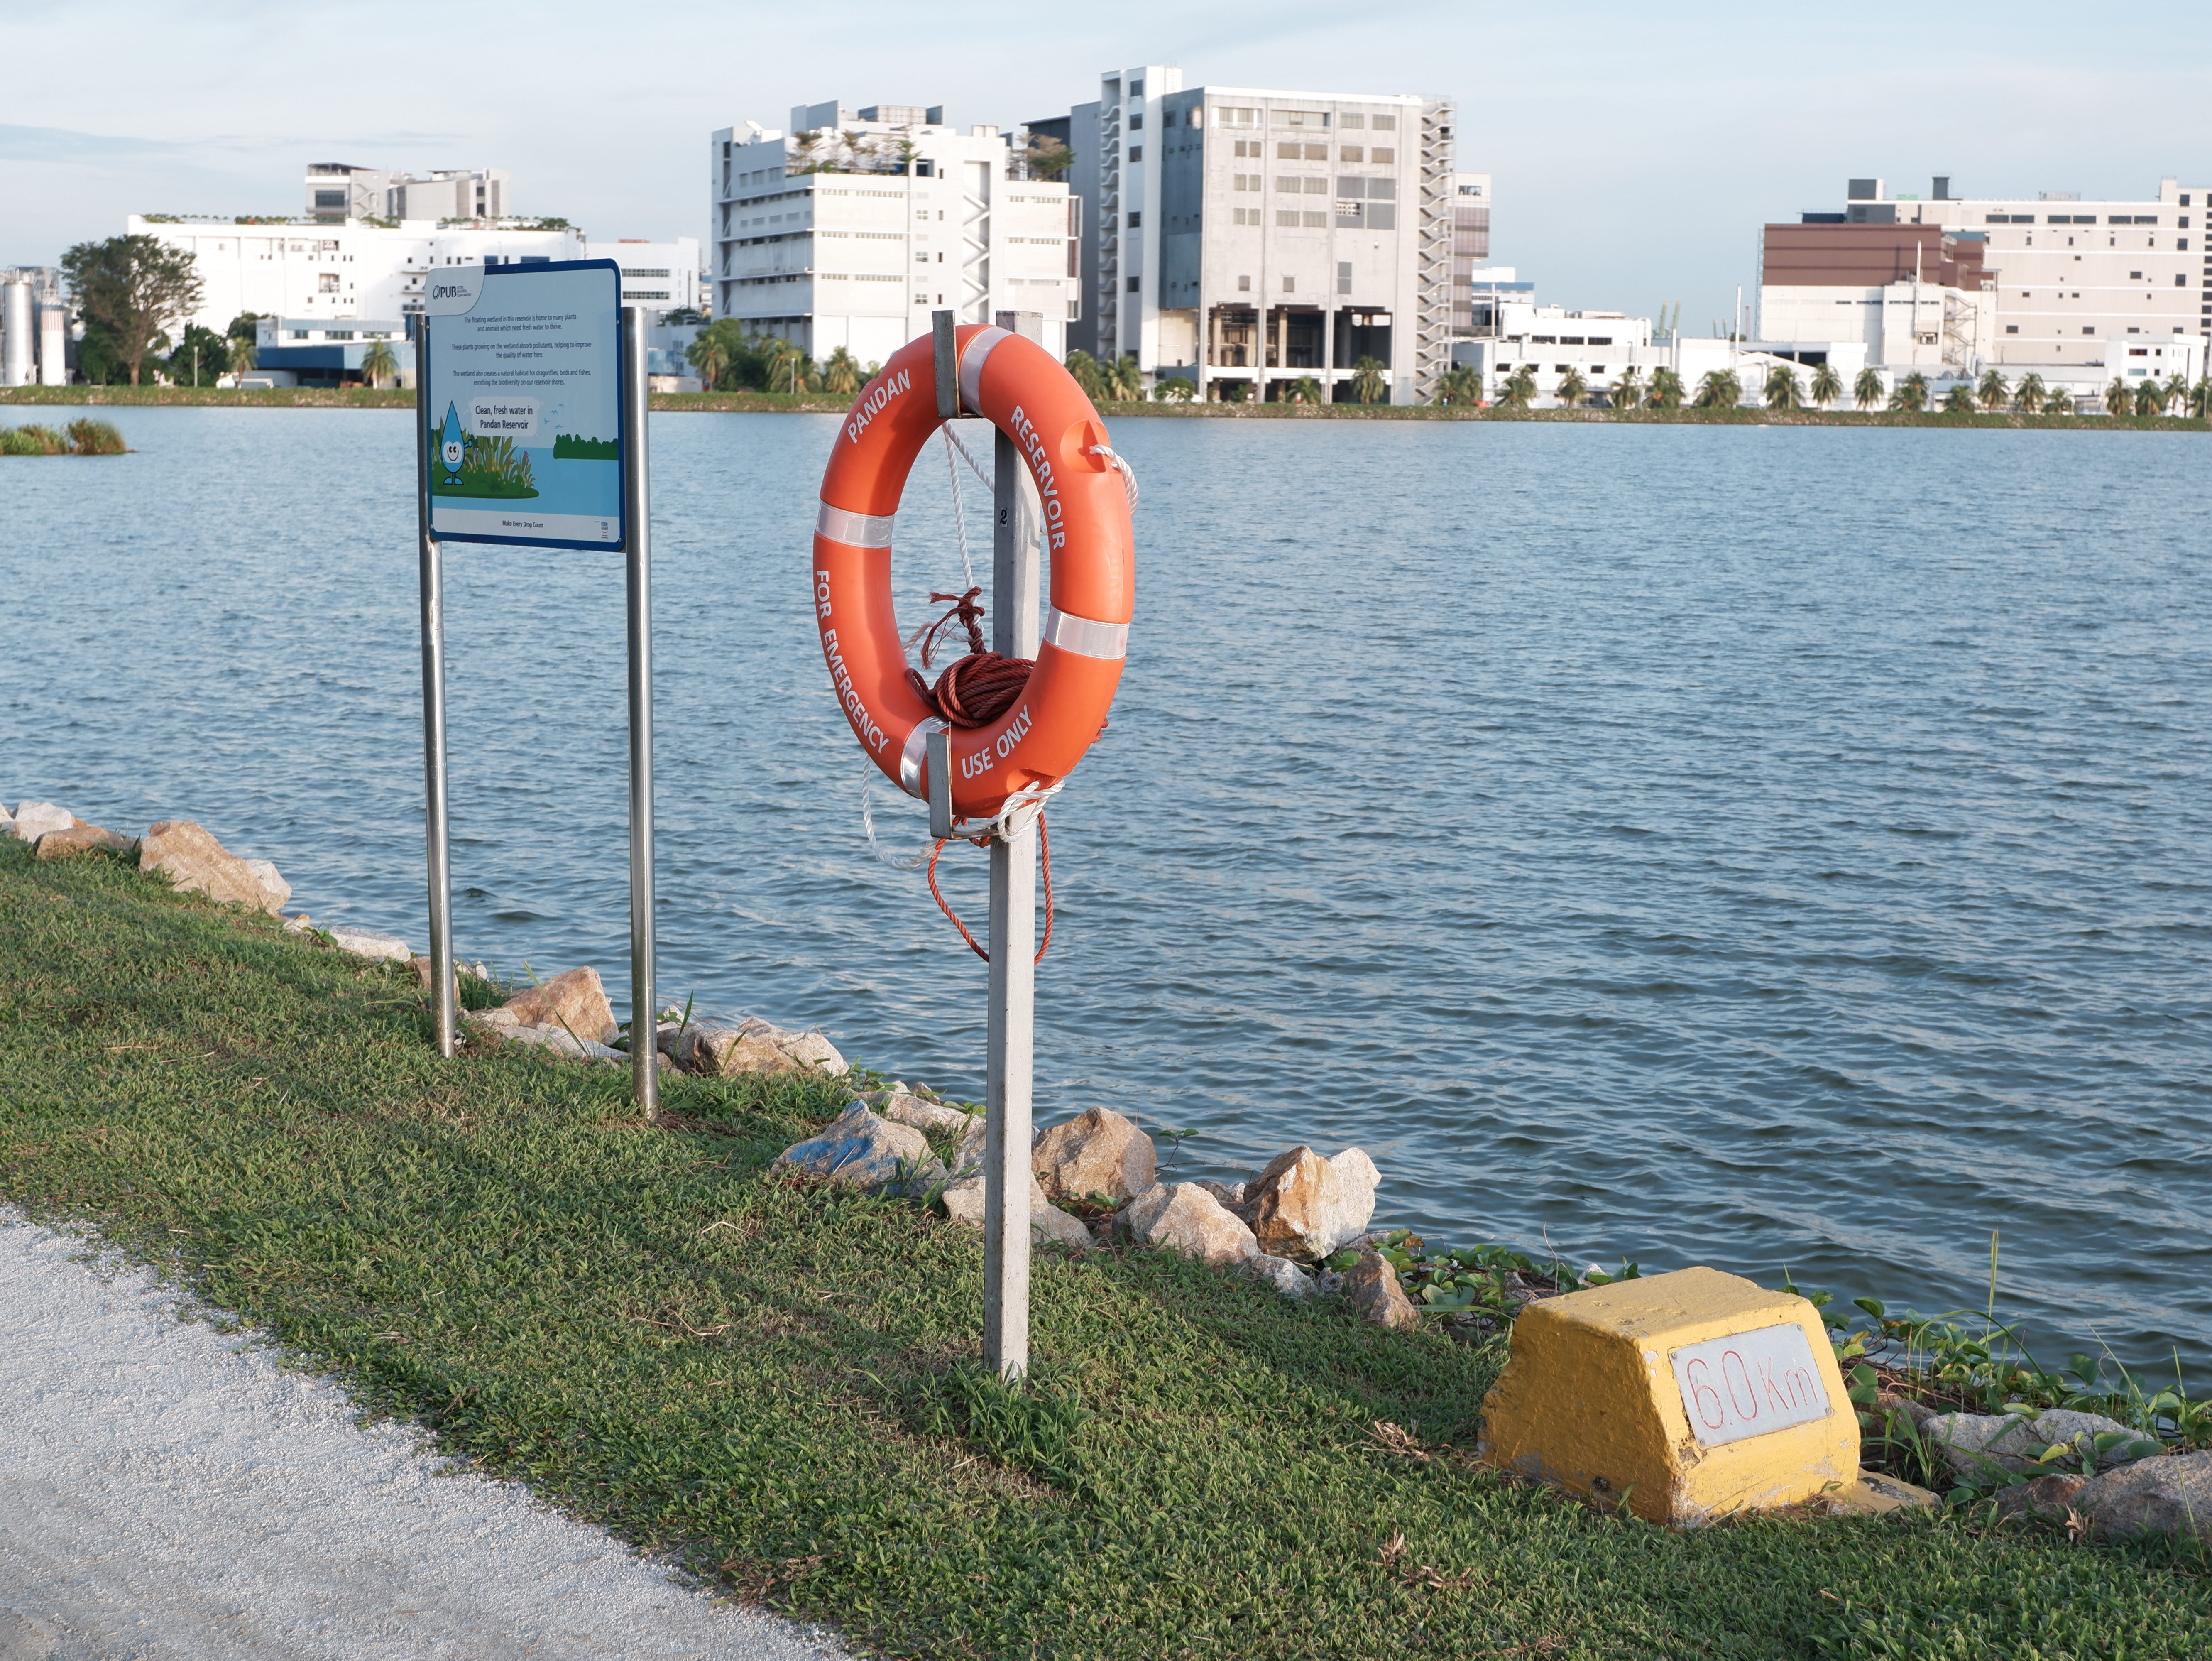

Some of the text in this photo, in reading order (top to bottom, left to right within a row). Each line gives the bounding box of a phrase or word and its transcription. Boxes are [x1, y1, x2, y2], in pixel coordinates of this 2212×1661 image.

[440, 286, 456, 298] PUB
[476, 405, 492, 415] Clean,
[494, 405, 507, 414] fresh
[527, 405, 533, 414] in
[480, 419, 528, 429] Pandan Reservoir
[847, 368, 1066, 551] PANDAN RESERVOIR
[1000, 509, 1007, 524] 2
[817, 570, 889, 754] FOR EMERGENCY
[962, 704, 1032, 779] USE ONLY
